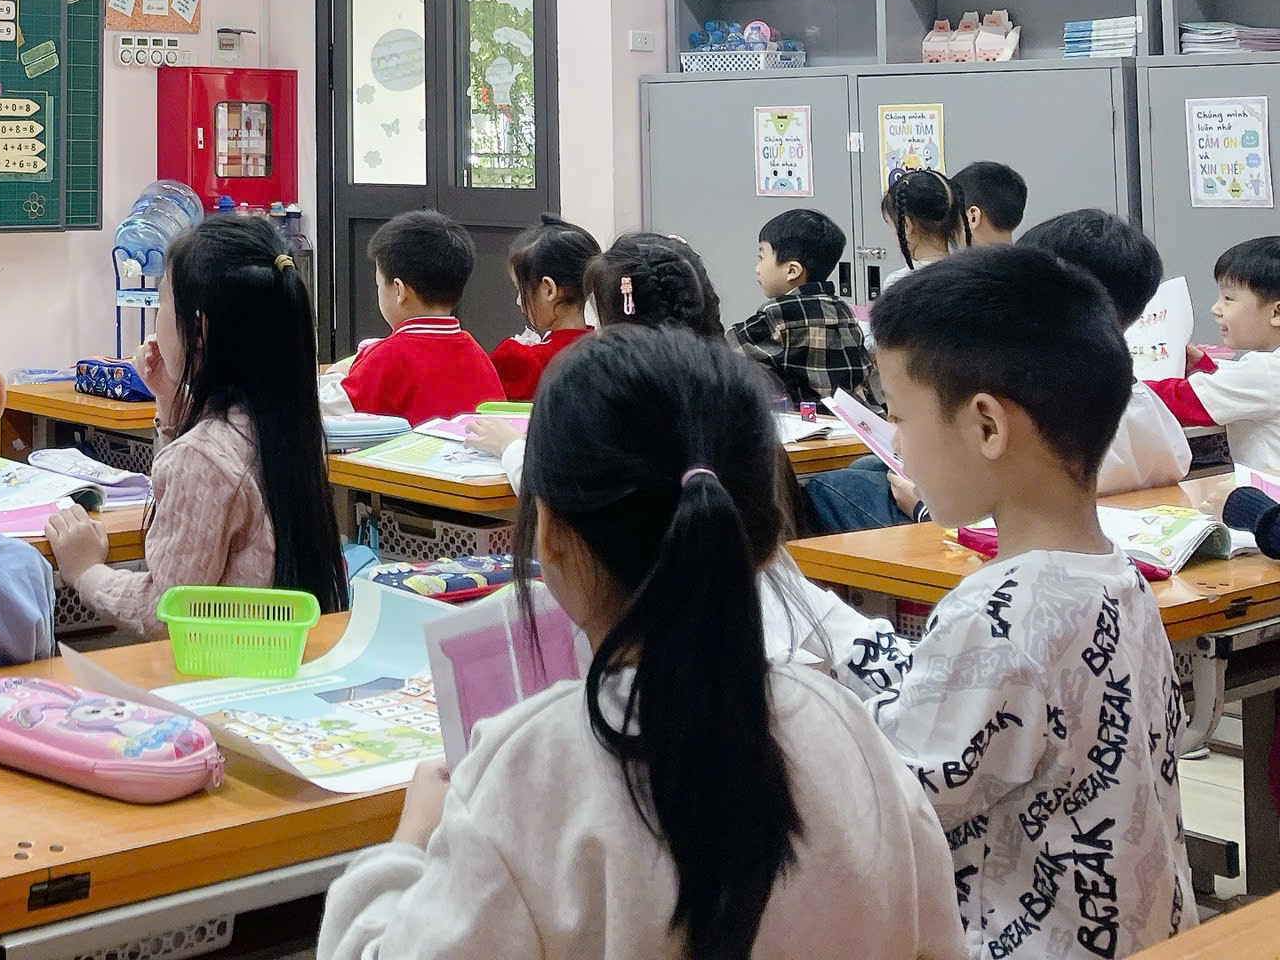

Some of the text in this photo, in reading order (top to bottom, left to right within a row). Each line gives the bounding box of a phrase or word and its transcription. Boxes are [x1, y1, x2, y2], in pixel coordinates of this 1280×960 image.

[885, 113, 906, 123] Chúng
[889, 123, 933, 136] QUAN TÂM
[1197, 110, 1248, 123] Chúng mình
[763, 144, 804, 159] GIÚP ĐỠ
[1199, 134, 1238, 149] CẢM ƠN
[1199, 152, 1210, 160] và
[1200, 161, 1245, 175] XIN PHÉP
[1082, 586, 1120, 677] BREAK
[1088, 668, 1132, 775] BREAK
[942, 701, 1024, 789] BREAK
[1063, 769, 1120, 816] BREAK
[1019, 842, 1074, 922] BREAK
[1071, 816, 1120, 960] BREAK
[988, 912, 1041, 960] BREAK
